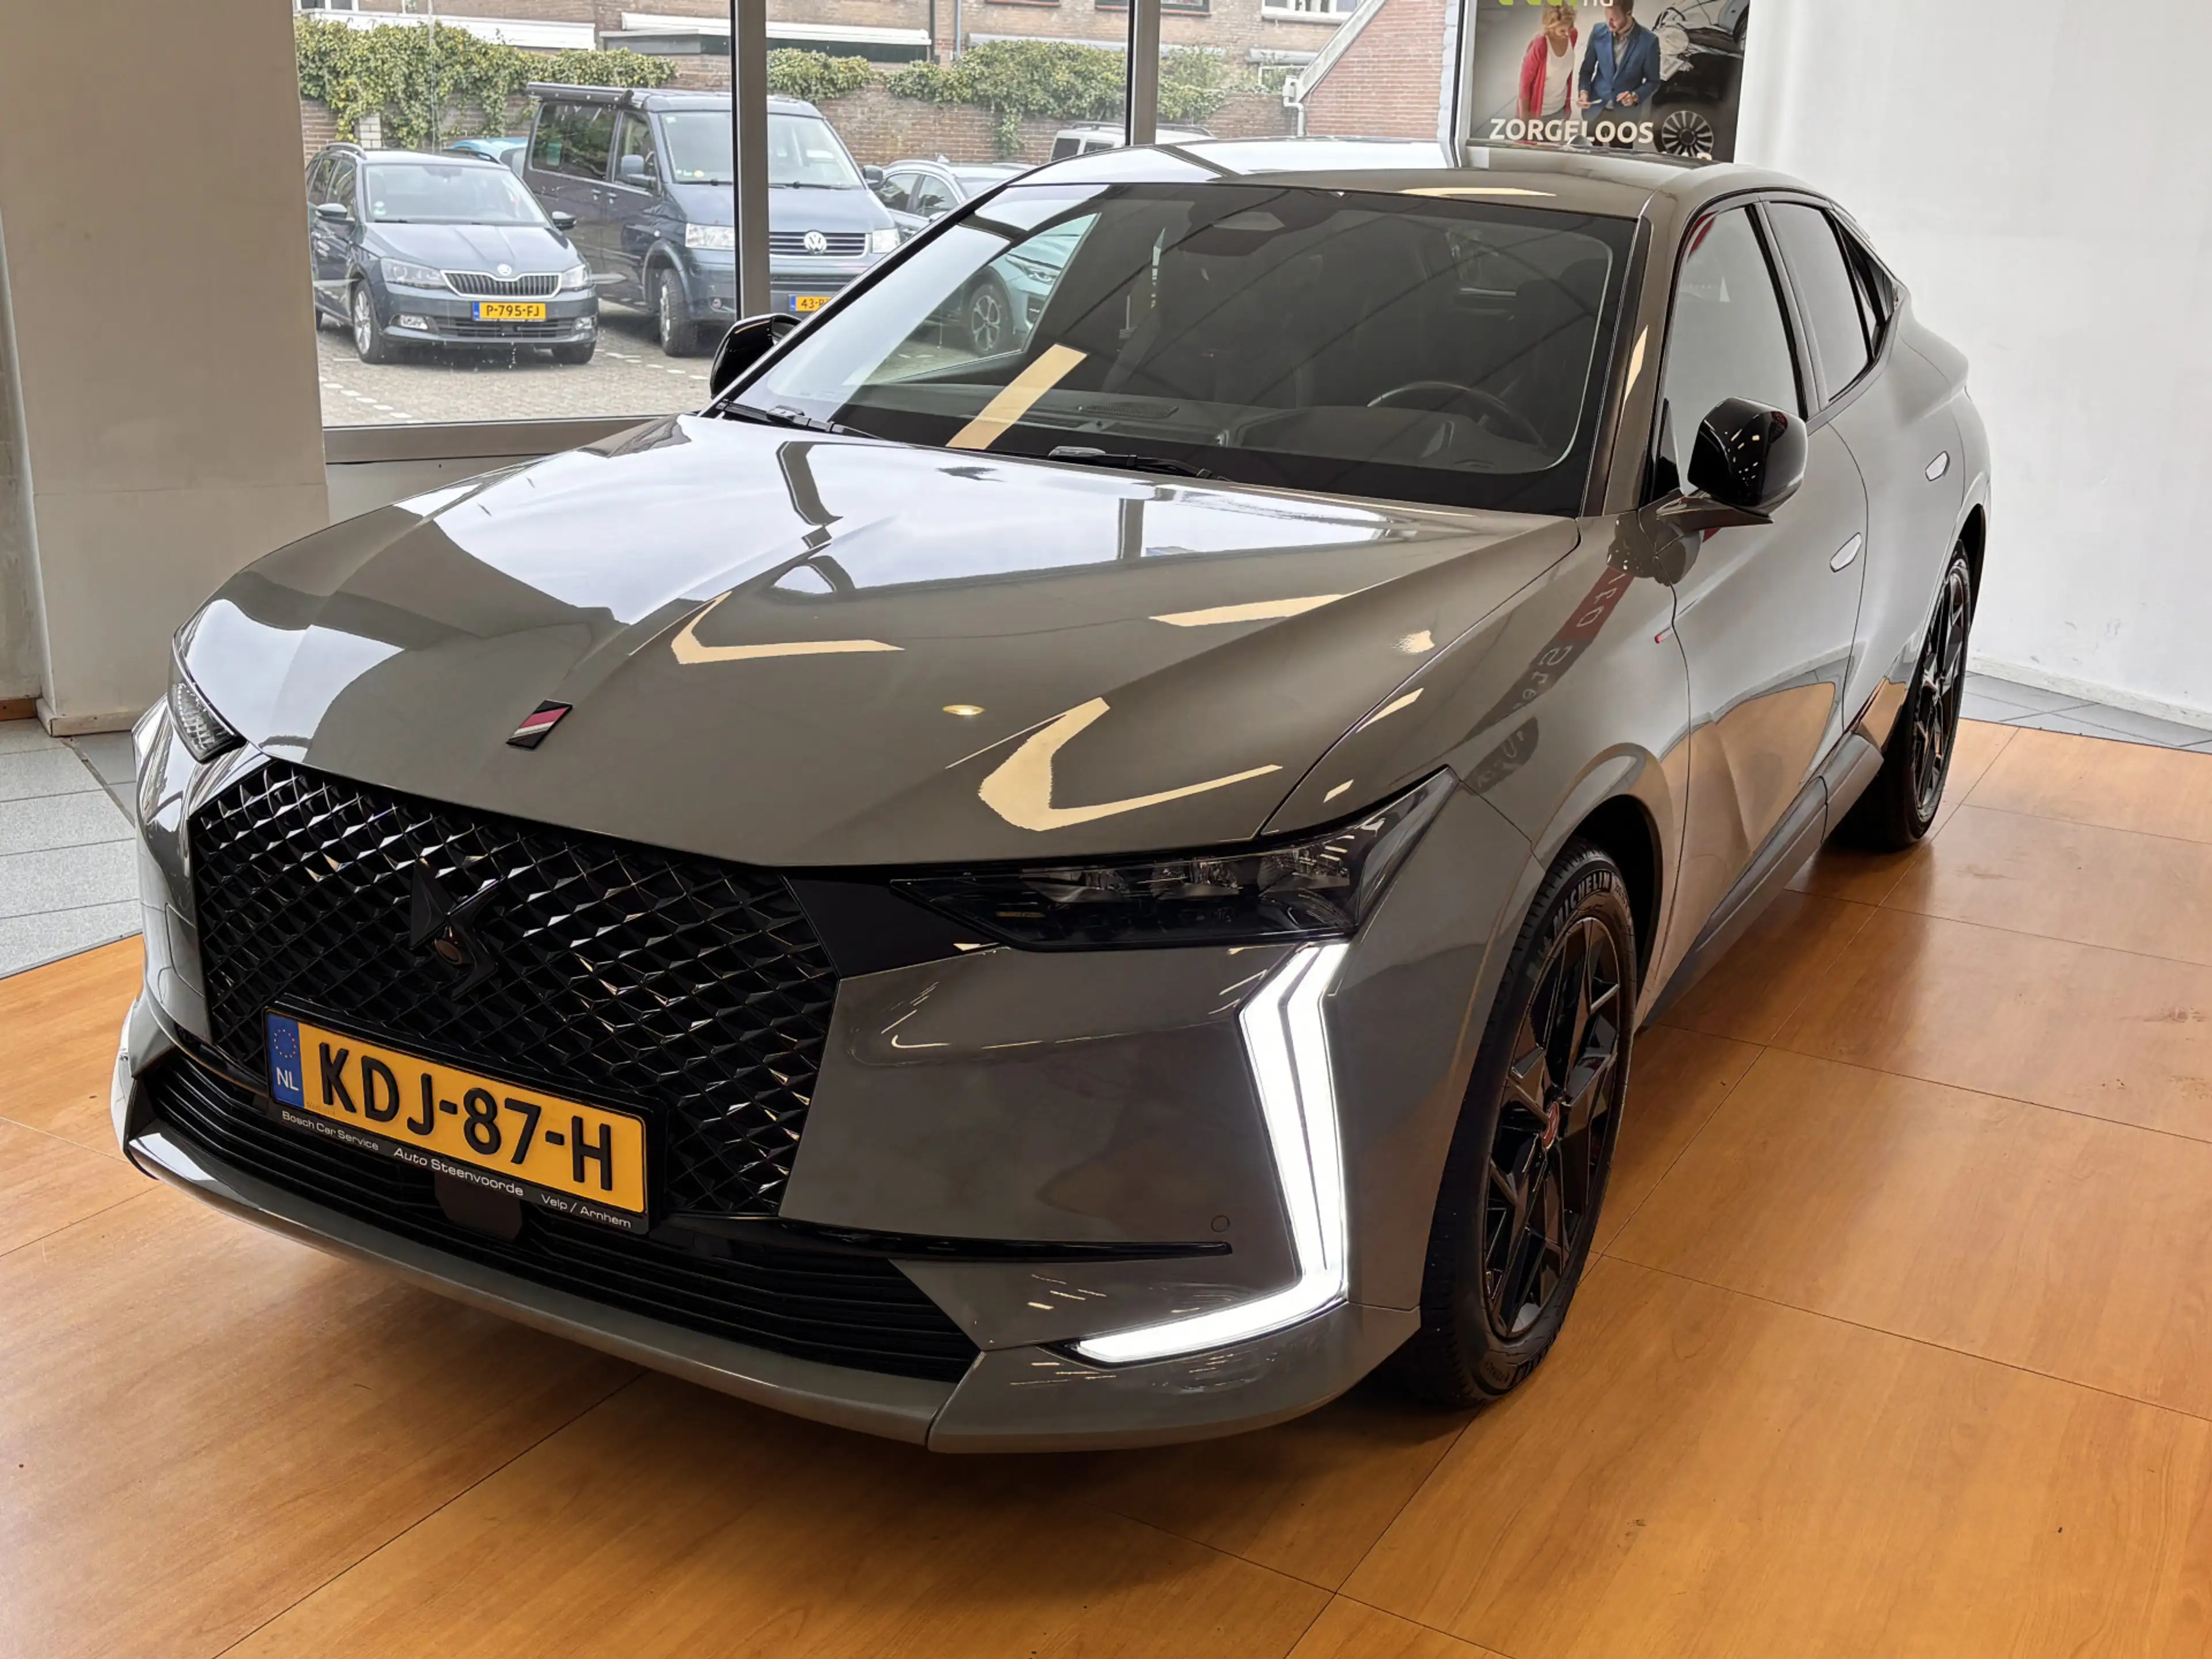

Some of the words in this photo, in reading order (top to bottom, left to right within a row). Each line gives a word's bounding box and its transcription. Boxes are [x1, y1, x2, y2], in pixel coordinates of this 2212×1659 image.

[1489, 119, 1654, 144] ZORGELOOS
[486, 305, 540, 317] P-795-FJ
[1552, 871, 1611, 937] MICHELIN
[276, 1067, 299, 1091] NL
[319, 1042, 613, 1191] KDJ-87-H
[282, 1110, 315, 1129] Bosch
[316, 1122, 336, 1137] Car
[337, 1129, 379, 1151] Service
[393, 1147, 428, 1166] Auto
[430, 1158, 524, 1196] Steenvoorde
[541, 1194, 568, 1210] Velp
[579, 1206, 631, 1229] Arnhem
